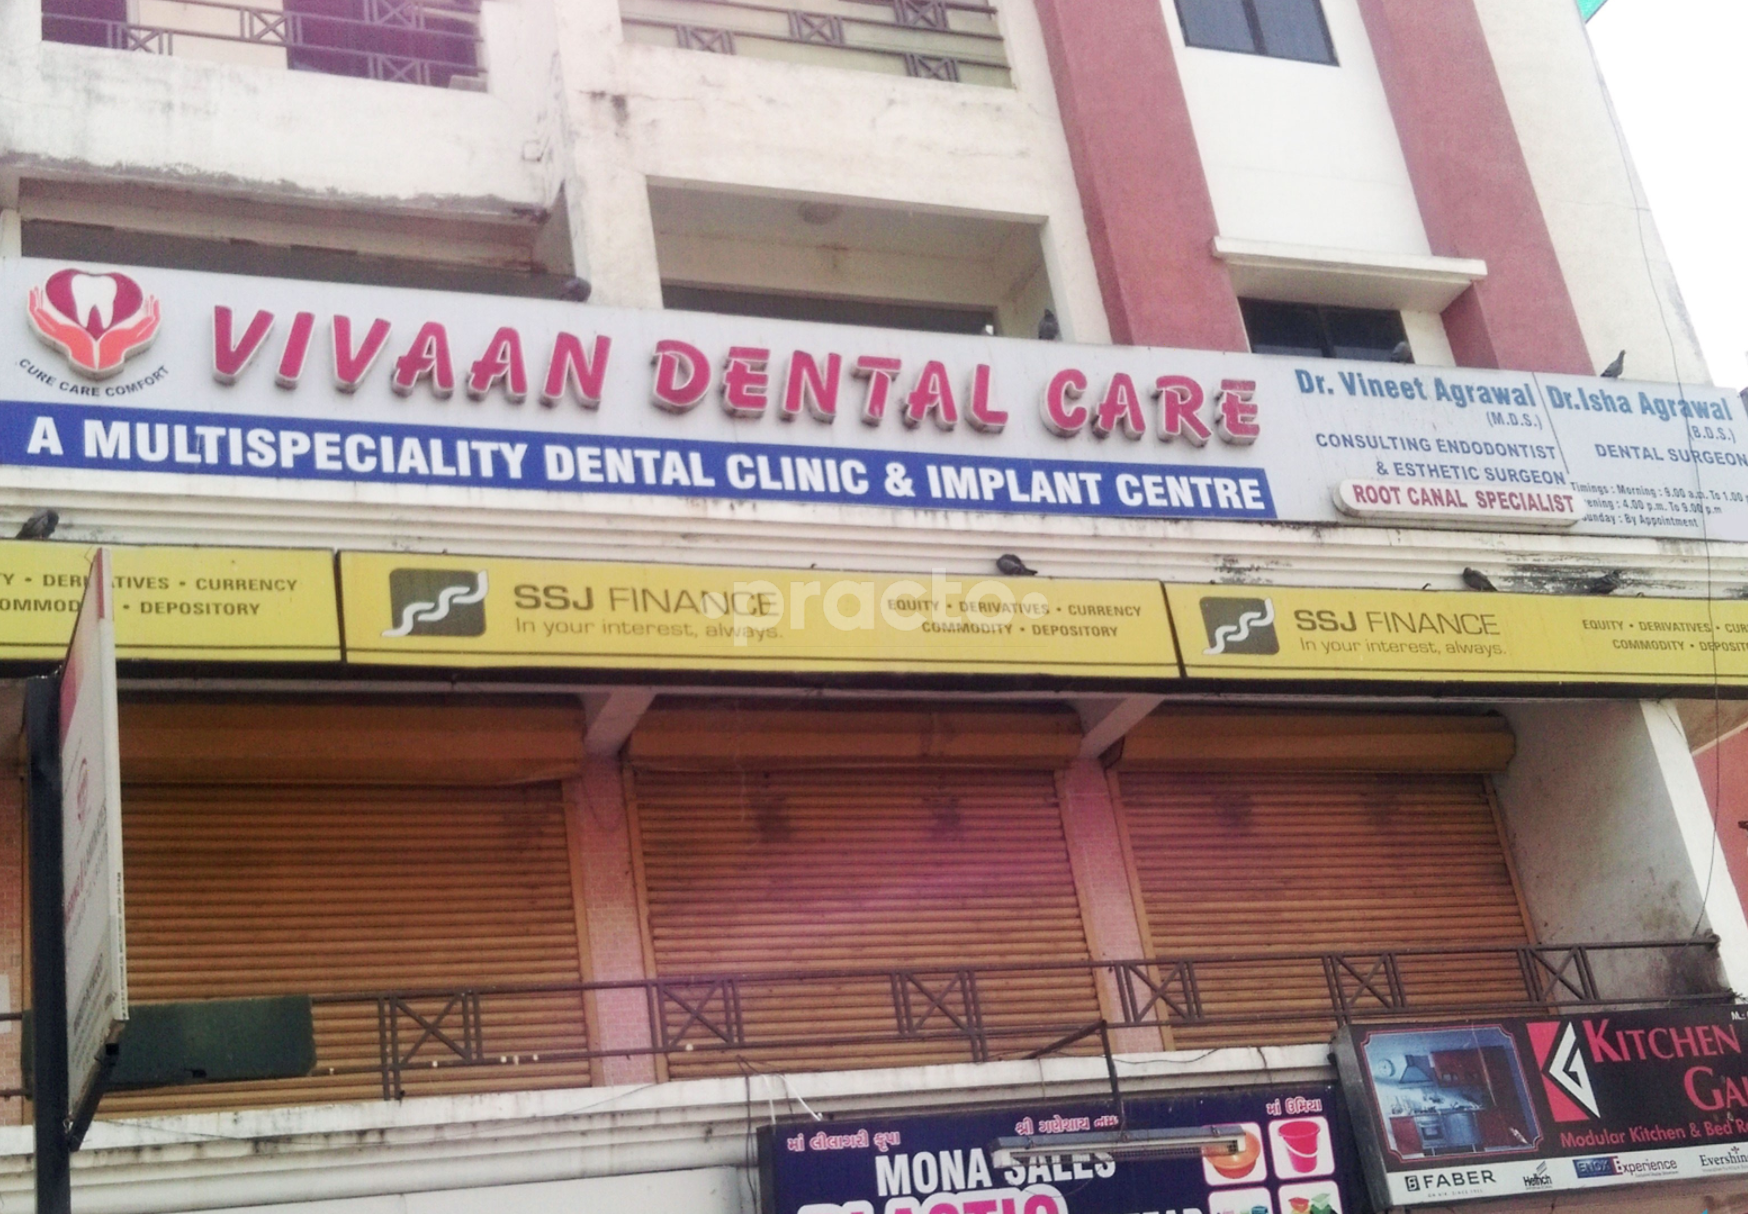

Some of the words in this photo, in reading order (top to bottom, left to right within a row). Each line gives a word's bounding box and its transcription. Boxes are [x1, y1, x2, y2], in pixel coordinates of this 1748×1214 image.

[19, 358, 57, 386] CURE
[59, 381, 100, 397] CARE
[105, 365, 170, 397] COMFORT
[213, 304, 612, 410] VIVAAN
[652, 339, 1008, 432] DENTAL
[1043, 368, 1260, 446] CARE
[1294, 369, 1334, 395] Dr.
[1338, 371, 1428, 401] Vineet
[1434, 377, 1537, 408] Agrawal
[1638, 391, 1734, 422] Agrawal
[1486, 411, 1543, 430] (M.D.S.)
[1315, 433, 1432, 452] CONSULTING
[1436, 438, 1556, 460] ENDODONTIST
[1594, 443, 1665, 461] DENTAL
[27, 416, 63, 456] A
[84, 419, 528, 479] MULTISPECIALITY
[544, 444, 716, 488] DENTAL
[726, 454, 869, 495] CLINIC
[884, 462, 916, 498] &
[926, 464, 1103, 505] IMPLANT
[1115, 473, 1266, 510] CENTRE
[1376, 461, 1389, 476] &
[1393, 461, 1481, 481] ESTHETIC
[1485, 466, 1566, 486] SURGEON
[1352, 484, 1402, 505] ROOT
[1407, 487, 1468, 508] CANAL
[1475, 490, 1574, 513] SPECIALIST
[1616, 484, 1657, 499] Morning
[1709, 490, 1721, 500] To
[1669, 501, 1680, 512] To
[1625, 513, 1637, 526] By
[1640, 514, 1699, 528] Appointment
[42, 574, 170, 589] DERITIVES
[195, 578, 298, 592] CURRENCY
[140, 601, 261, 616] DEPOSITORY
[513, 584, 594, 612] SSJ
[608, 586, 780, 617] FINANCE
[887, 598, 940, 613] EQUITY
[958, 600, 1050, 616] DERIVATIVES
[1068, 604, 1141, 617] CURRENCY
[516, 617, 536, 633] In
[544, 620, 594, 637] your
[602, 618, 698, 639] interest,
[705, 621, 784, 641] always.
[921, 621, 1013, 635] COMMODITY
[1031, 624, 1118, 638] DEPOSITORY
[1293, 609, 1358, 632] SSJ
[1366, 611, 1500, 636] FINANCE
[1582, 619, 1624, 630] EQUITY
[1638, 621, 1712, 633] DERIVATIVES
[1300, 637, 1317, 651] In
[1321, 640, 1361, 655] your
[1365, 639, 1442, 655] interest,
[1445, 640, 1507, 657] always.
[1612, 639, 1685, 651] COMMODITY
[1582, 1018, 1742, 1064] KITCHEN
[1560, 1127, 1626, 1149] Modular
[1629, 1124, 1687, 1143] Kitchen
[1689, 1122, 1702, 1138] &
[1704, 1119, 1733, 1137] Bed
[875, 1148, 993, 1197] MONA
[1003, 1150, 1117, 1186] SALES
[1423, 1169, 1497, 1189] FABER
